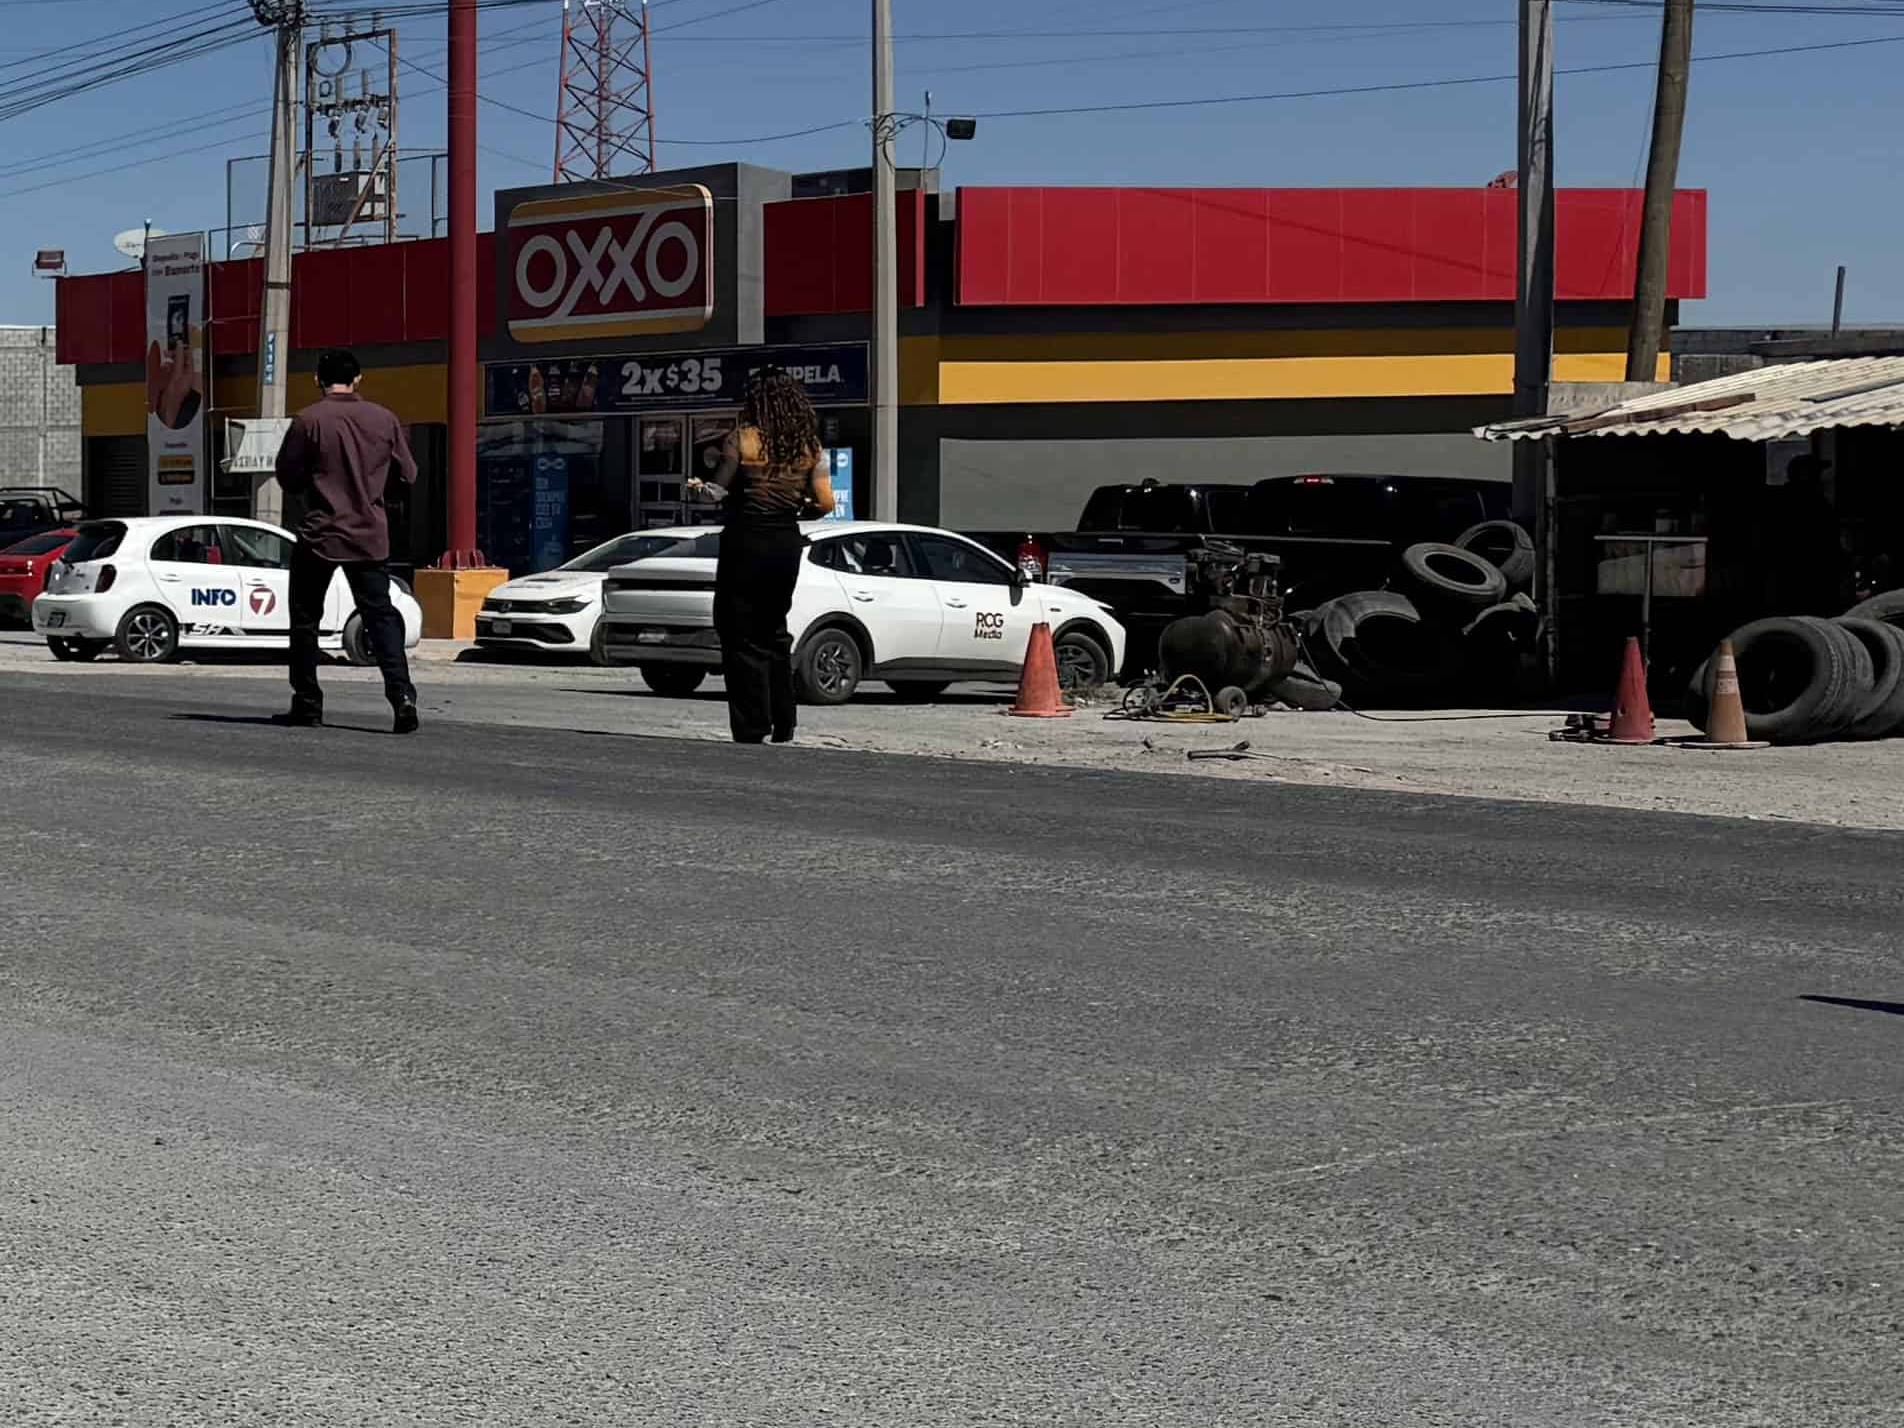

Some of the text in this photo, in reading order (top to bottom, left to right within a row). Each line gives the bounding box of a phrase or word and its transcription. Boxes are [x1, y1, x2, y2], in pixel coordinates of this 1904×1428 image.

[516, 220, 699, 308] OXXO
[620, 357, 723, 396] 2x$35
[191, 588, 237, 606] INFO
[976, 612, 1004, 628] RCG
